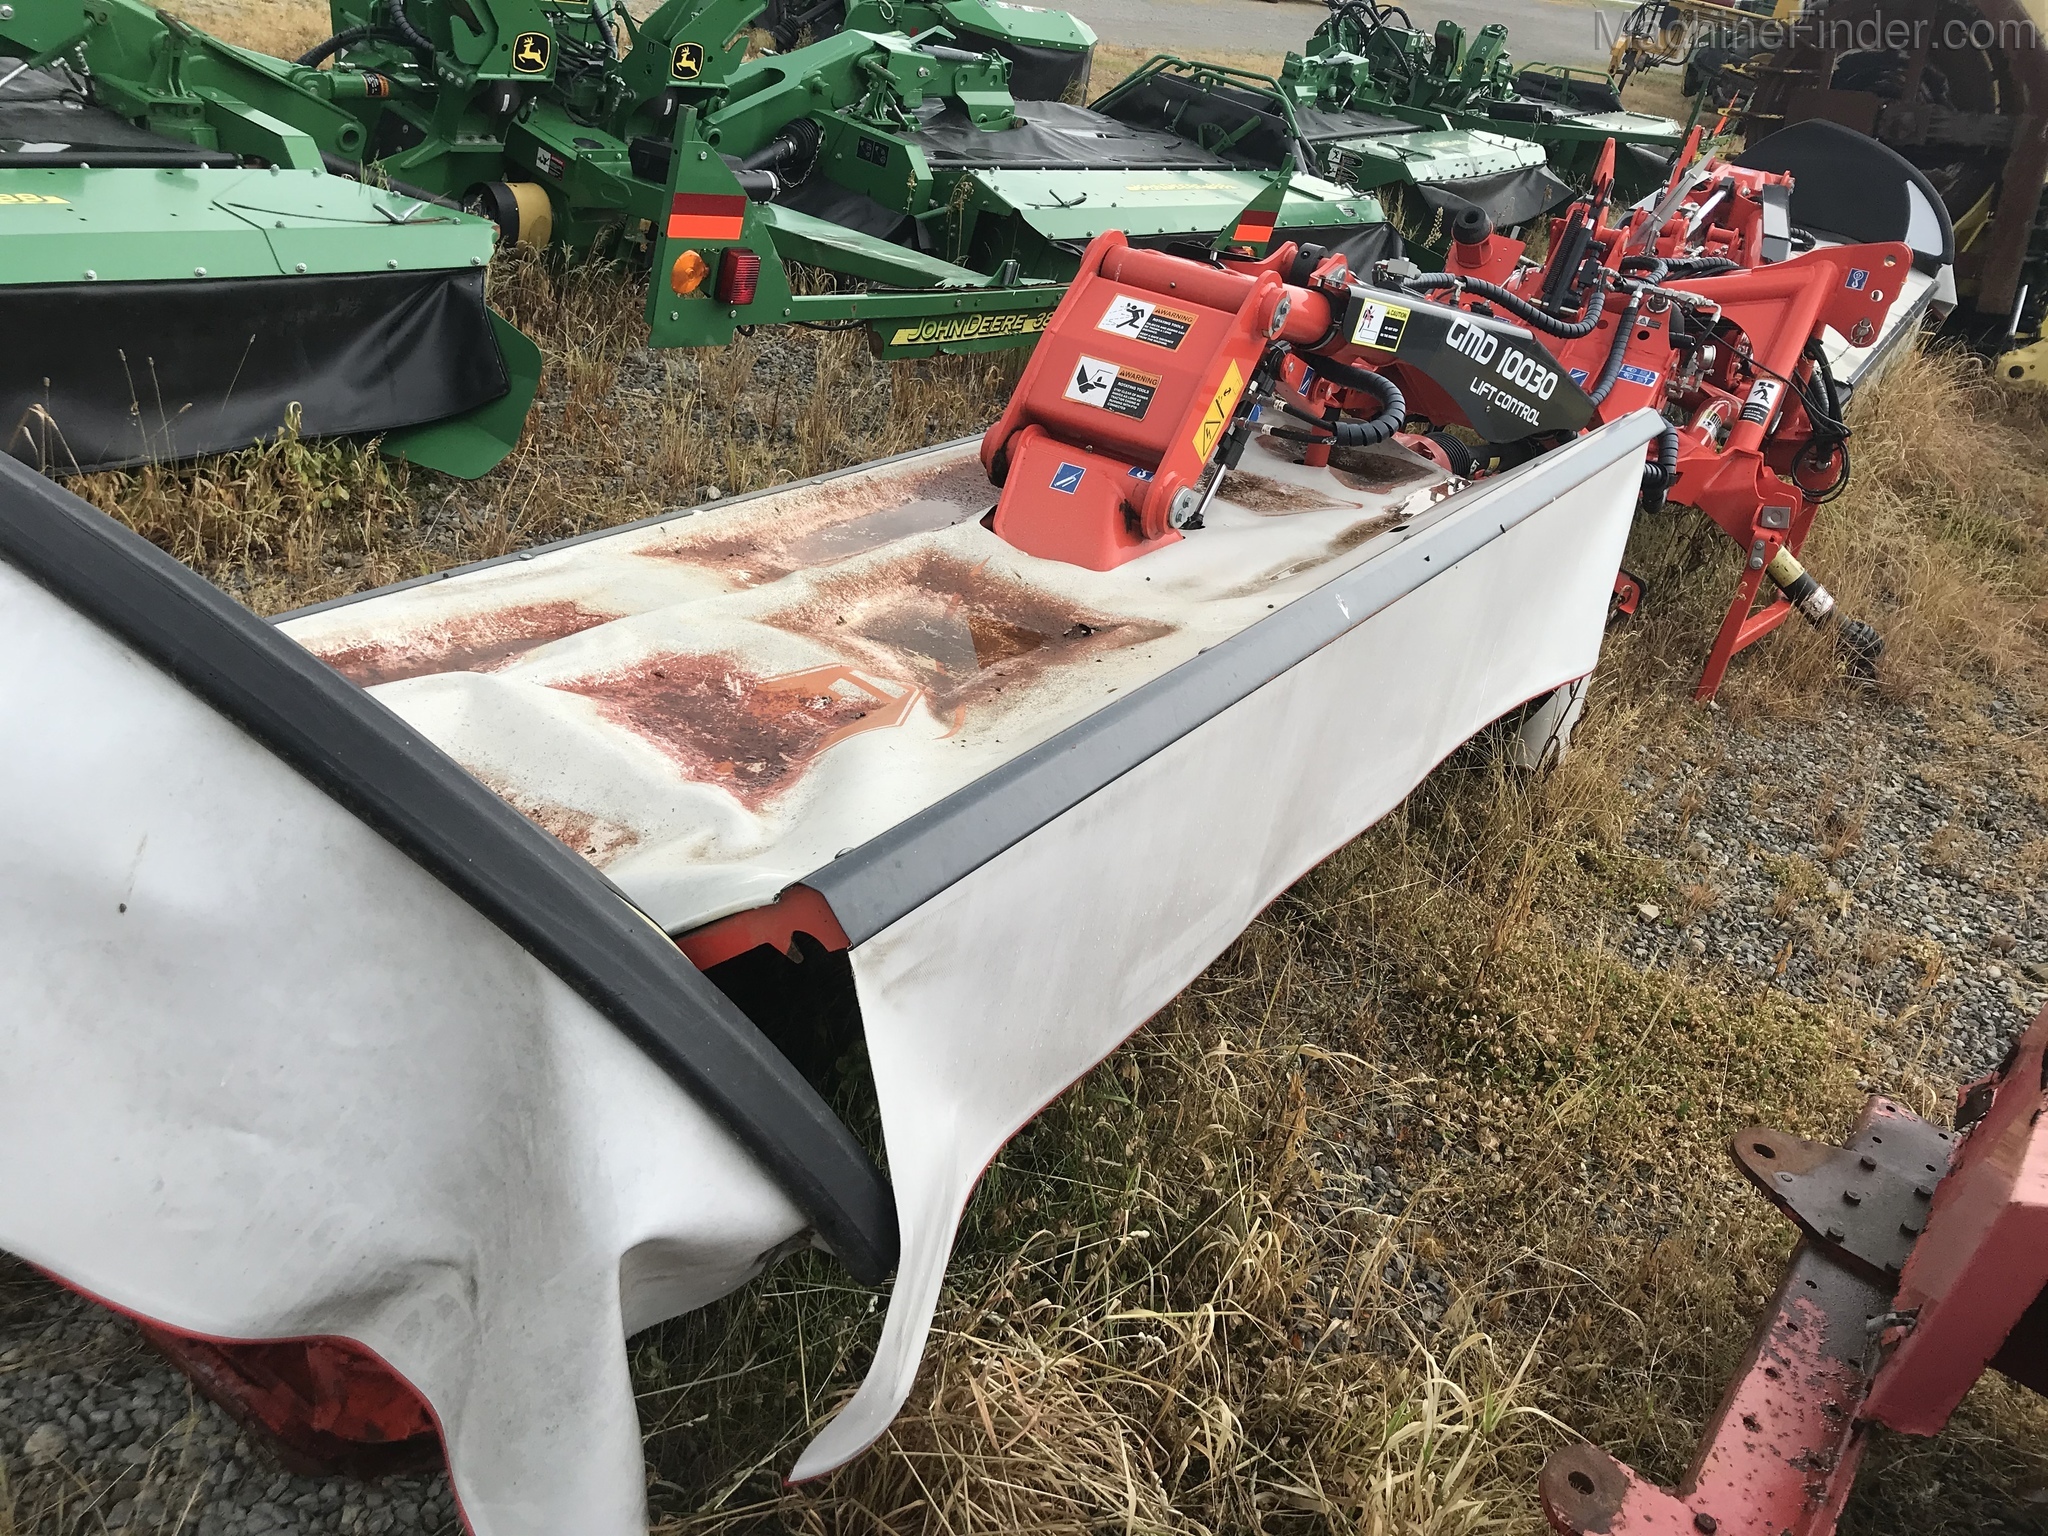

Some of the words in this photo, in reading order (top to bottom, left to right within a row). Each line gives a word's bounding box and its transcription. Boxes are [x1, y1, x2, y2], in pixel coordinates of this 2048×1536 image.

[907, 318, 965, 342] JOHN
[964, 313, 1028, 335] DEERE
[1160, 309, 1193, 322] WARNING
[1446, 317, 1499, 365] GMD
[1495, 346, 1559, 401] 10030
[1124, 371, 1158, 386] WARNING
[1469, 376, 1498, 400] LIFT
[1494, 391, 1540, 426] CONTROL
